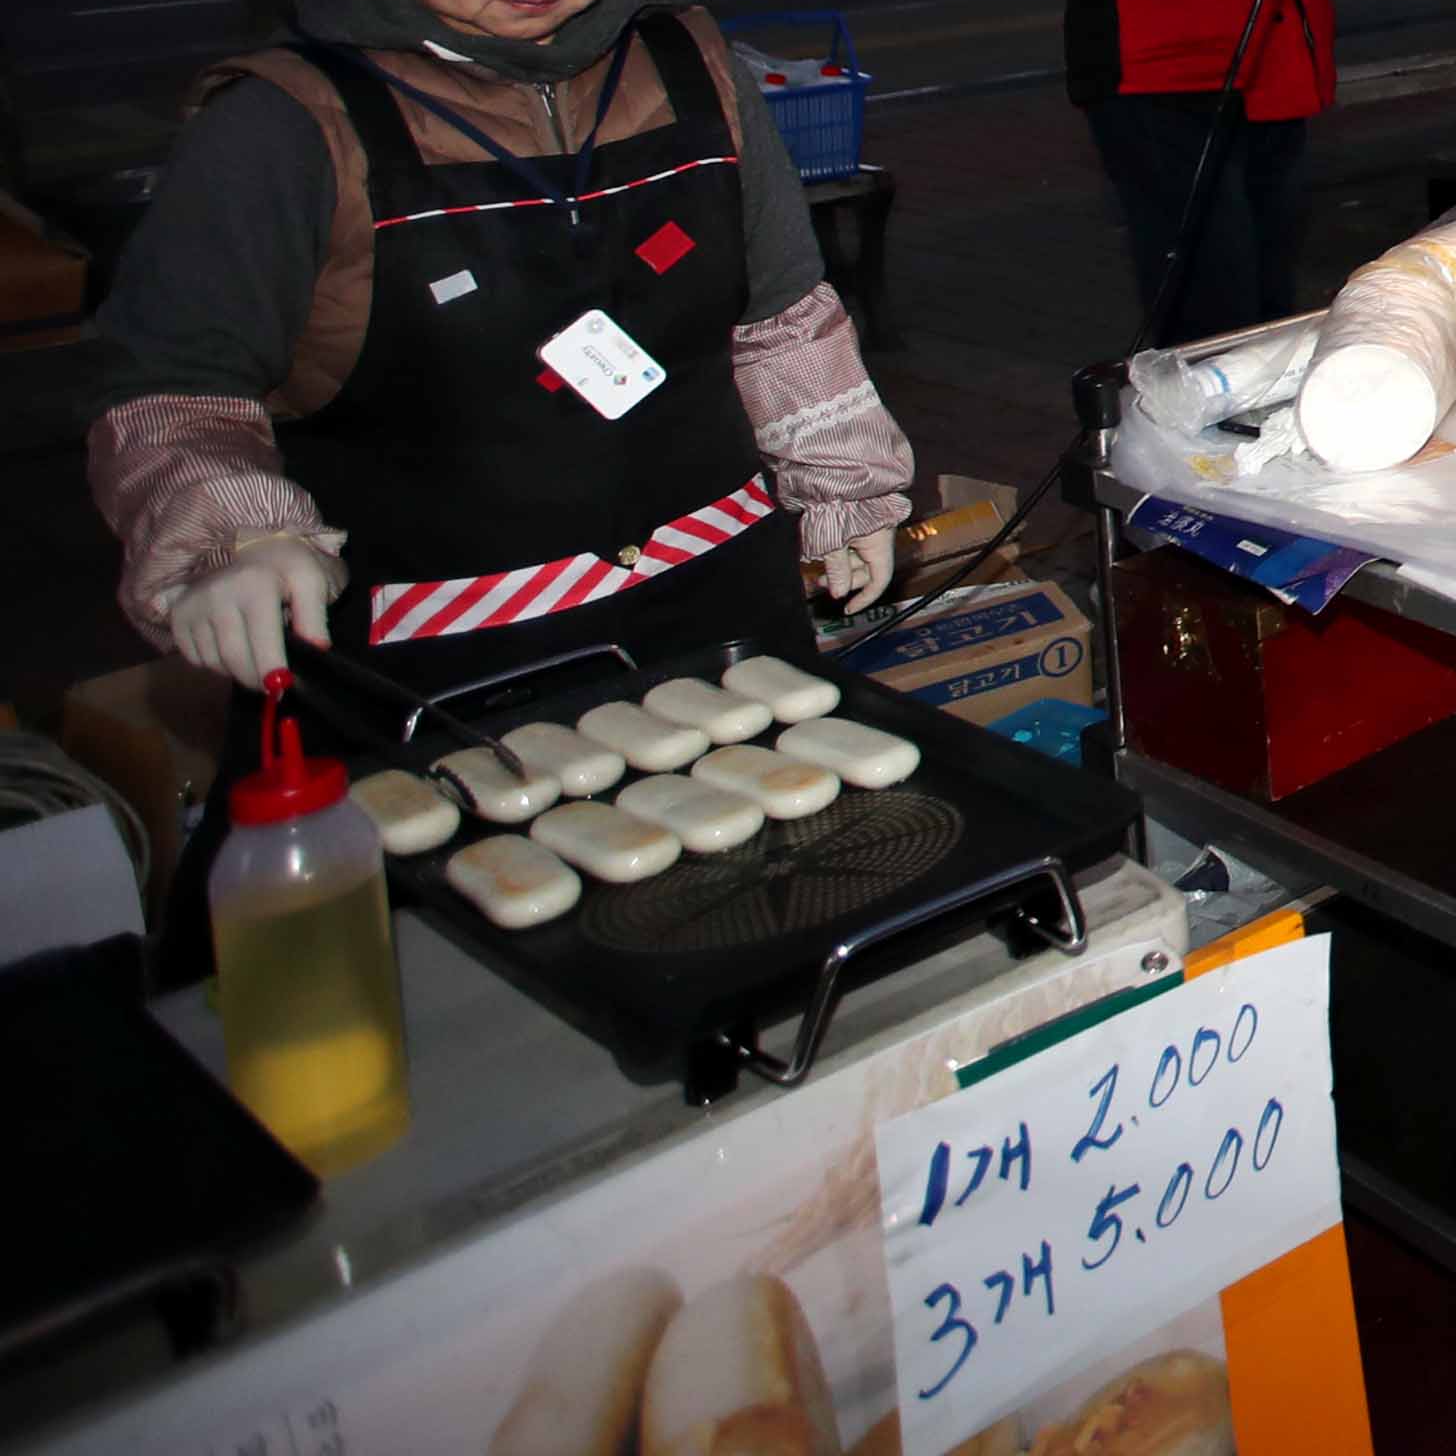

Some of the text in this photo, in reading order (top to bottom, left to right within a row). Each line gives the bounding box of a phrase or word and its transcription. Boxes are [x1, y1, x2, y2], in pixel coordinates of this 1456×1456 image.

[947, 662, 1022, 699] 닭고기
[918, 1121, 1032, 1227] 1개
[917, 1097, 1284, 1400] 3개 5.000
